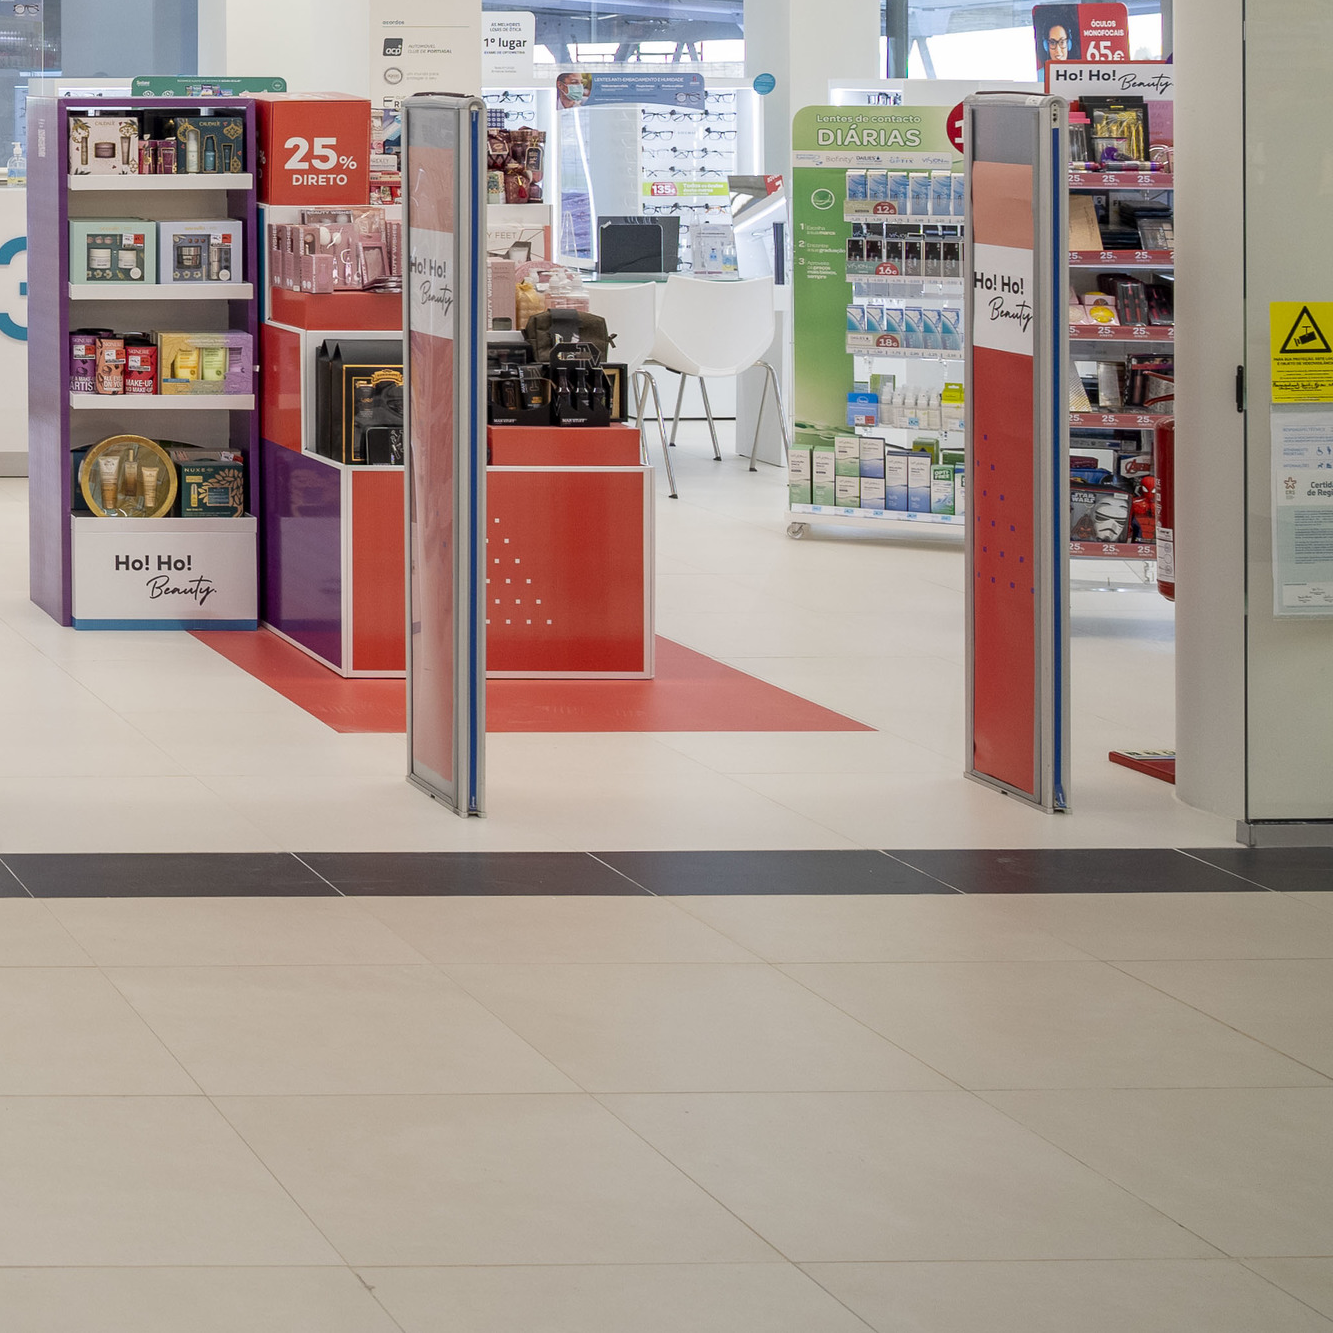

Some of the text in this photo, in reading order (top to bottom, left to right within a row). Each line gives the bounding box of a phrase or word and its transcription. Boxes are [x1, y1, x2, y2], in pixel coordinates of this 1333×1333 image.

[1091, 19, 1116, 28] ÓCULOS
[1083, 29, 1124, 37] MONOFOCAIS
[498, 37, 527, 50] lugar
[1086, 41, 1125, 61] 65€
[1055, 69, 1083, 81] Ho!
[1088, 69, 1117, 81] Ho!
[816, 114, 921, 123] Lentes de contacto
[816, 124, 921, 147] DIÁRIAS
[284, 136, 357, 172] 25%
[292, 174, 348, 186] DIRETO
[494, 231, 517, 239] FEET
[410, 255, 446, 279] Ho! Ho!
[974, 271, 1024, 295] Ho! Ho!
[1317, 489, 1333, 497] Regi
[115, 554, 192, 571] Ho! Ho!
